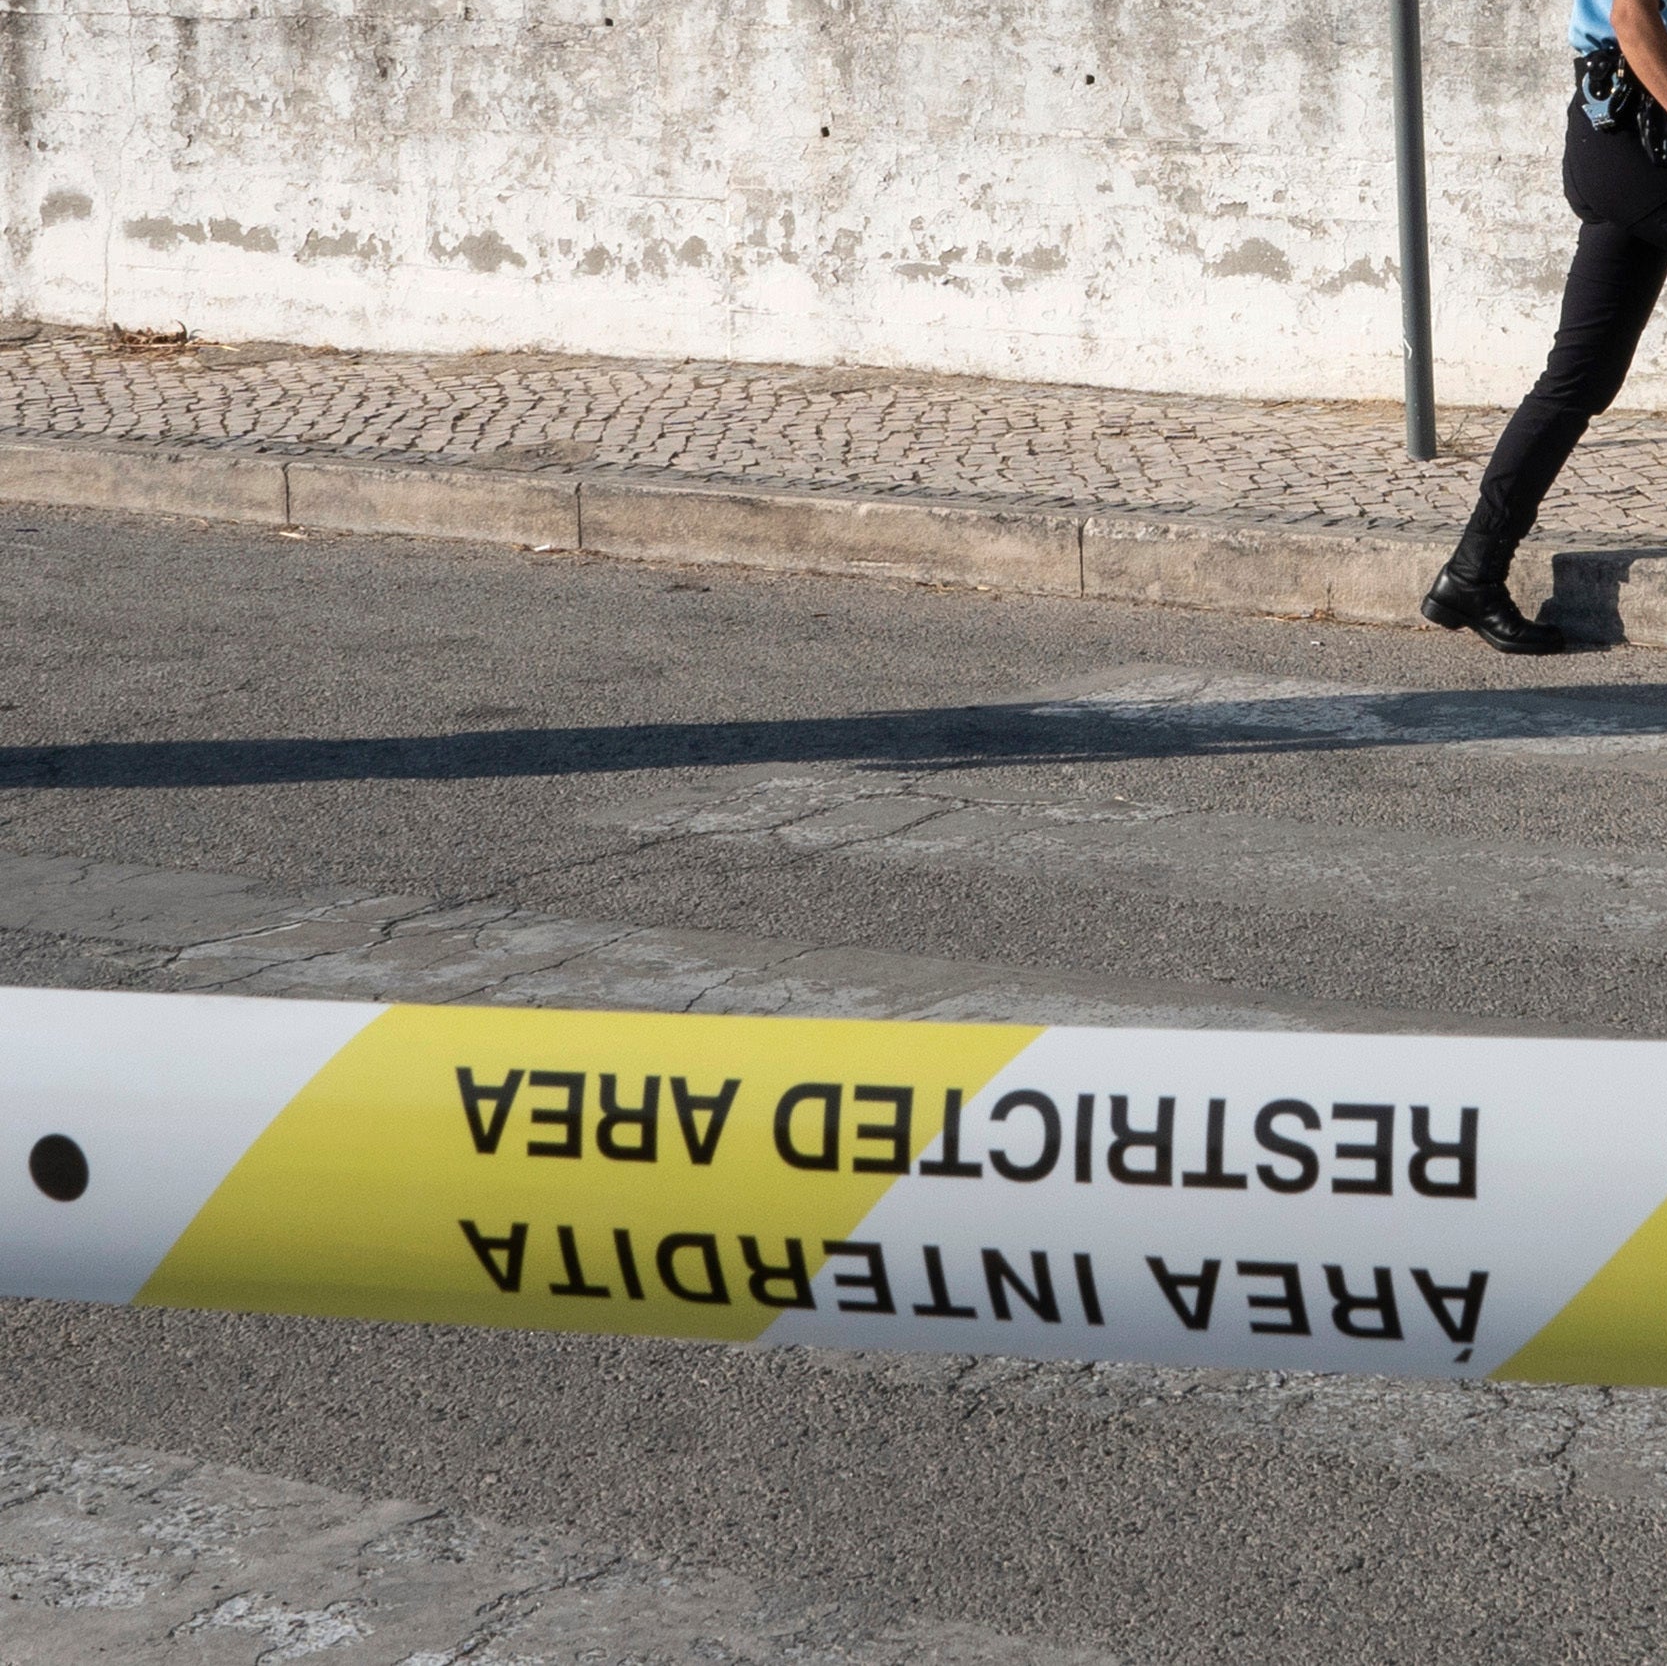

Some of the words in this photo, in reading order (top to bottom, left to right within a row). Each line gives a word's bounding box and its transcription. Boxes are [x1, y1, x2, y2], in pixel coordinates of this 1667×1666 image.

[456, 1066, 741, 1166] AREA
[773, 1083, 1479, 1200] RESTRICTED
[457, 1218, 1107, 1328] INTERDITA
[1145, 1256, 1490, 1365] ÁREA
